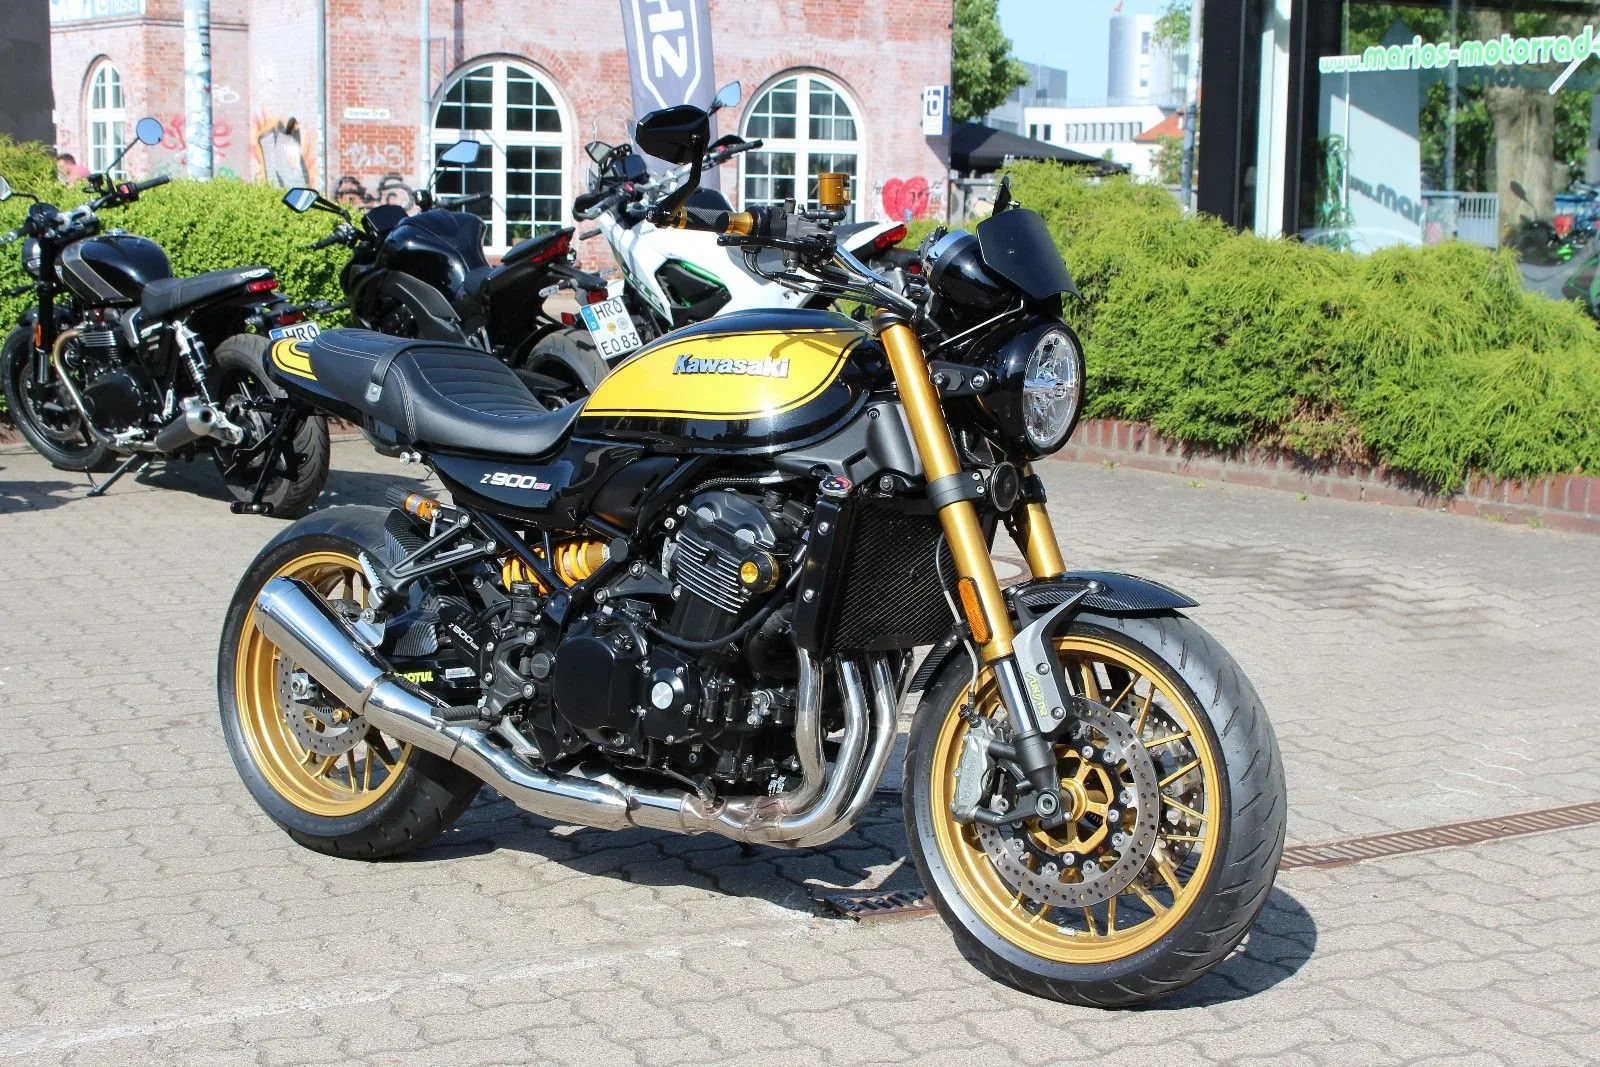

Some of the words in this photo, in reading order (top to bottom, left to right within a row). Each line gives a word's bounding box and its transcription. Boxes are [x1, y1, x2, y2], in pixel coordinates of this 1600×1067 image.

[594, 299, 623, 320] HRO
[285, 324, 318, 341] HRO
[673, 353, 790, 379] Kawasaki
[403, 671, 434, 683] OTUL
